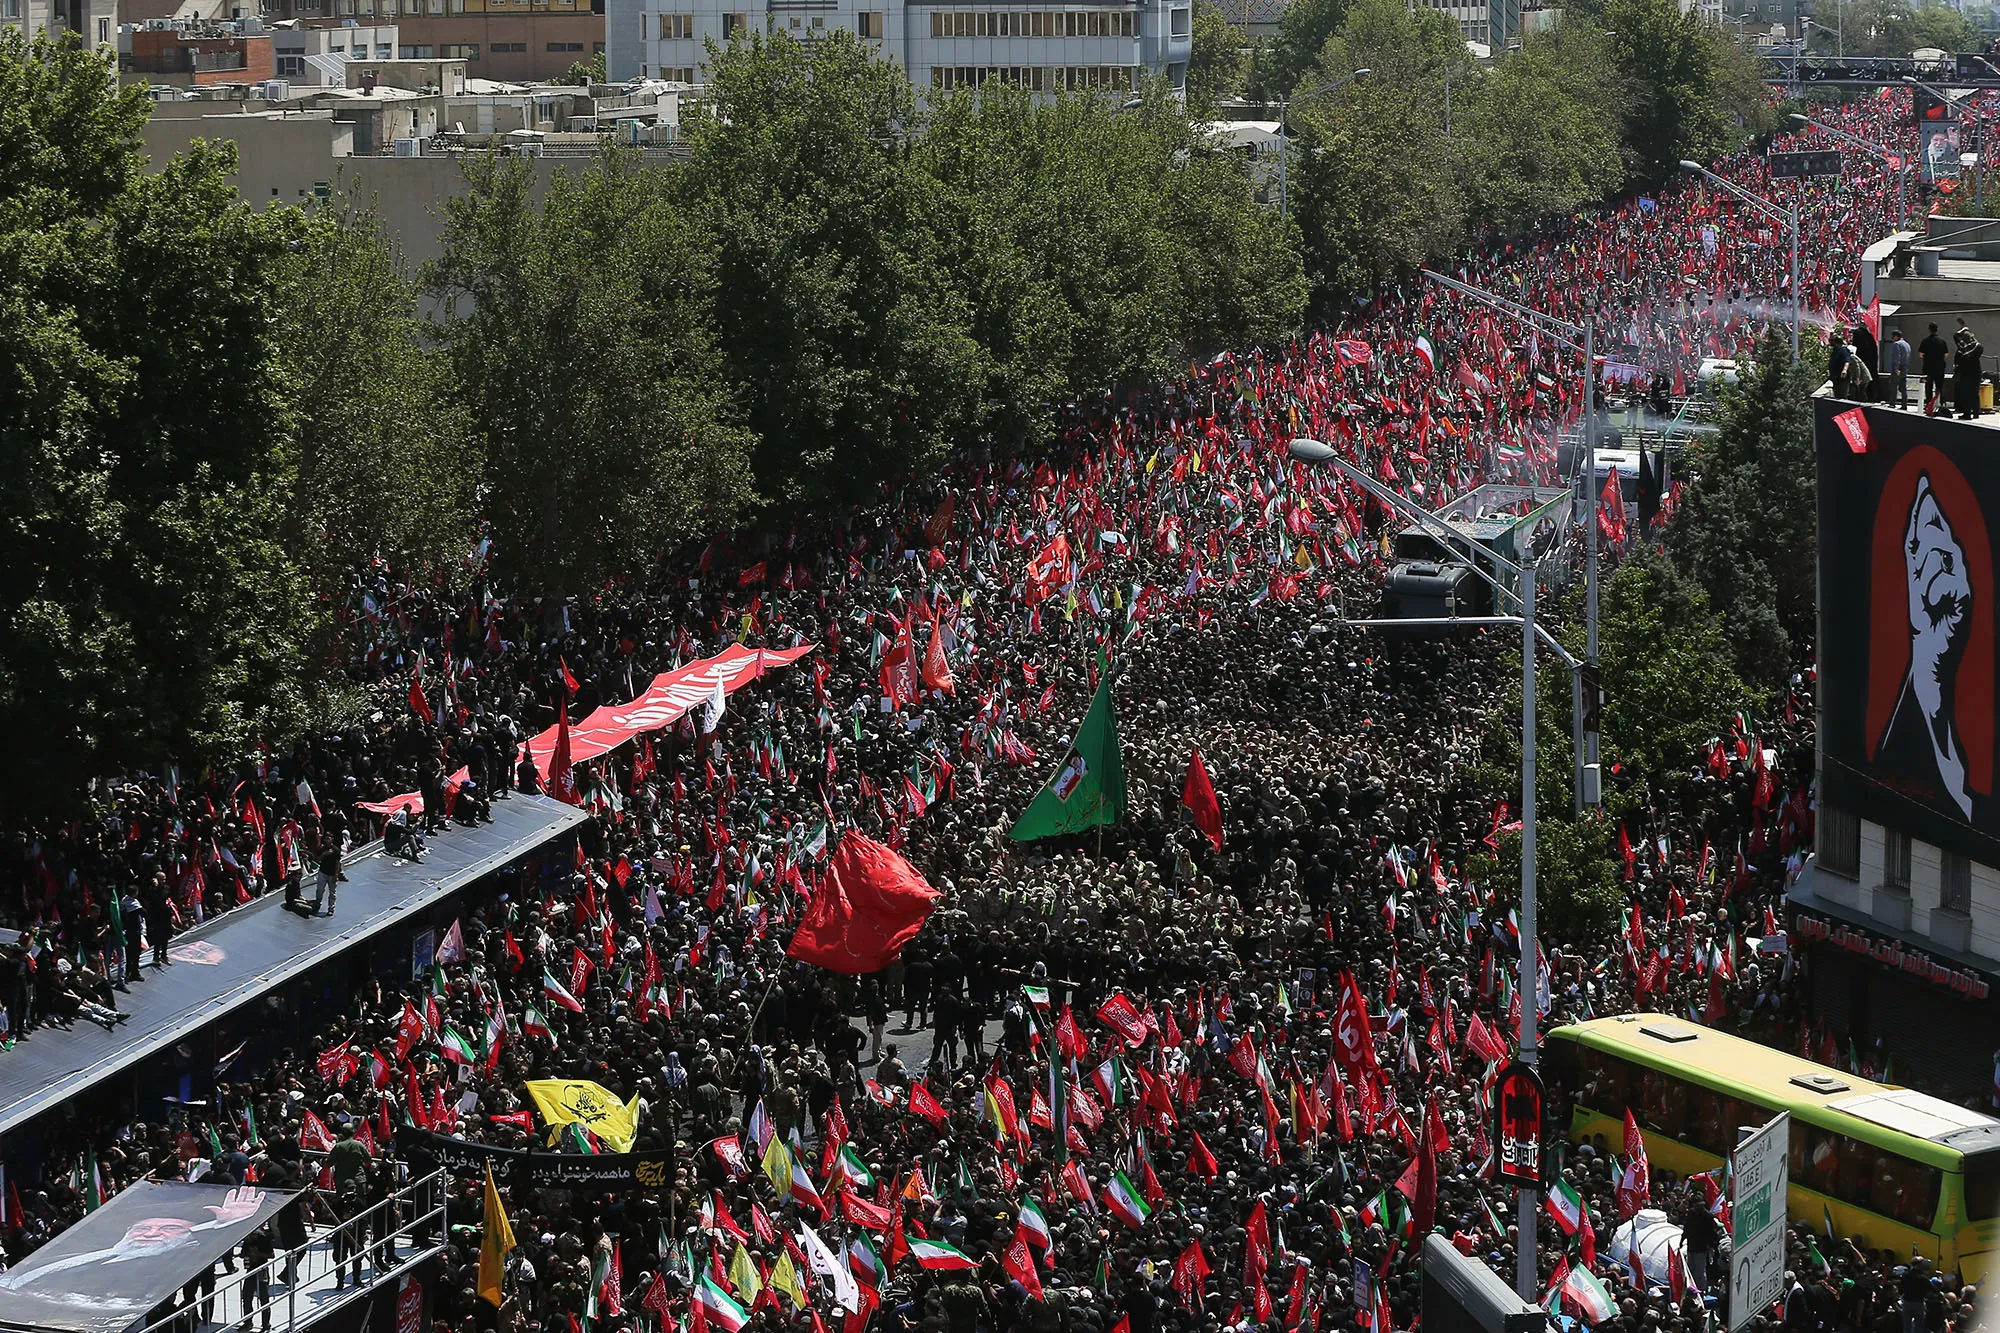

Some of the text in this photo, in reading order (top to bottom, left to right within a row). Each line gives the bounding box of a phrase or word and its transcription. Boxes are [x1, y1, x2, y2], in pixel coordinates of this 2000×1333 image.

[469, 1156, 481, 1171] به
[532, 1168, 550, 1185] پدر
[1742, 1167, 1761, 1191] 146 E
[1749, 1215, 1757, 1233] 47
